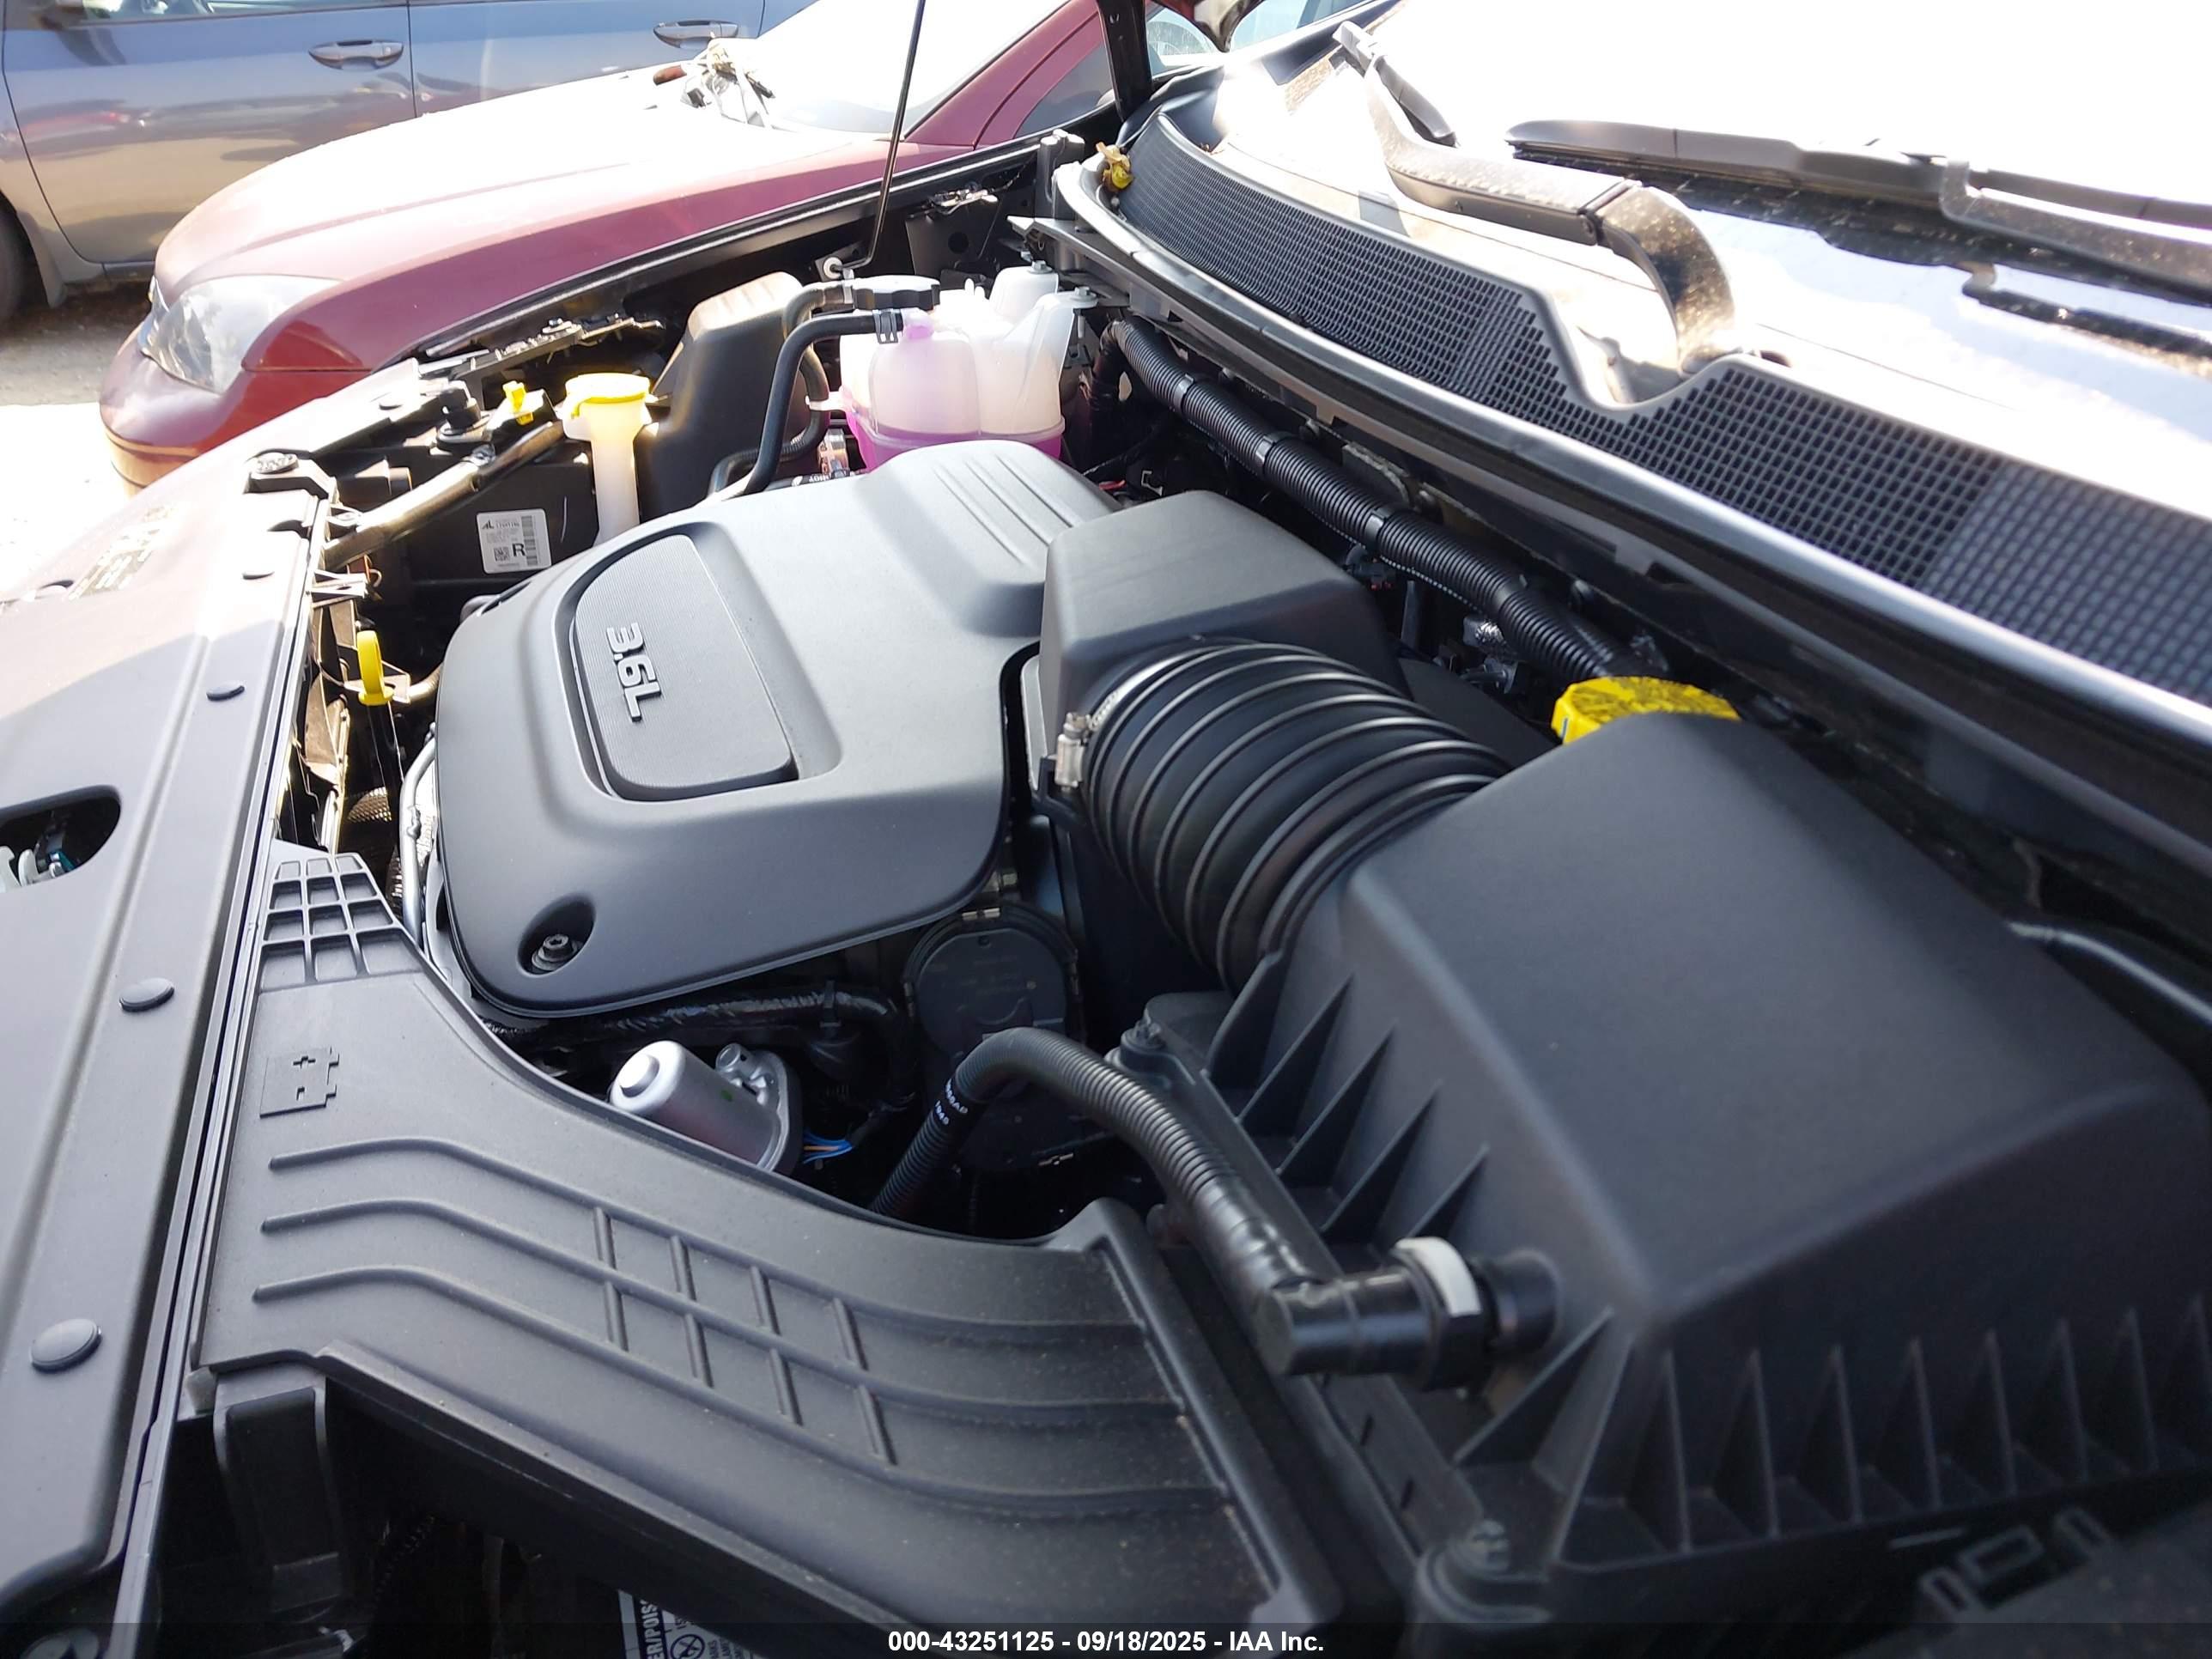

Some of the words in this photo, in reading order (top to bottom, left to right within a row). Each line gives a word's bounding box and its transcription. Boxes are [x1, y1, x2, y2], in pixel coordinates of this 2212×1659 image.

[512, 543, 526, 557] R
[606, 622, 662, 723] 3.6L
[640, 1599, 665, 1659] ER/POIS
